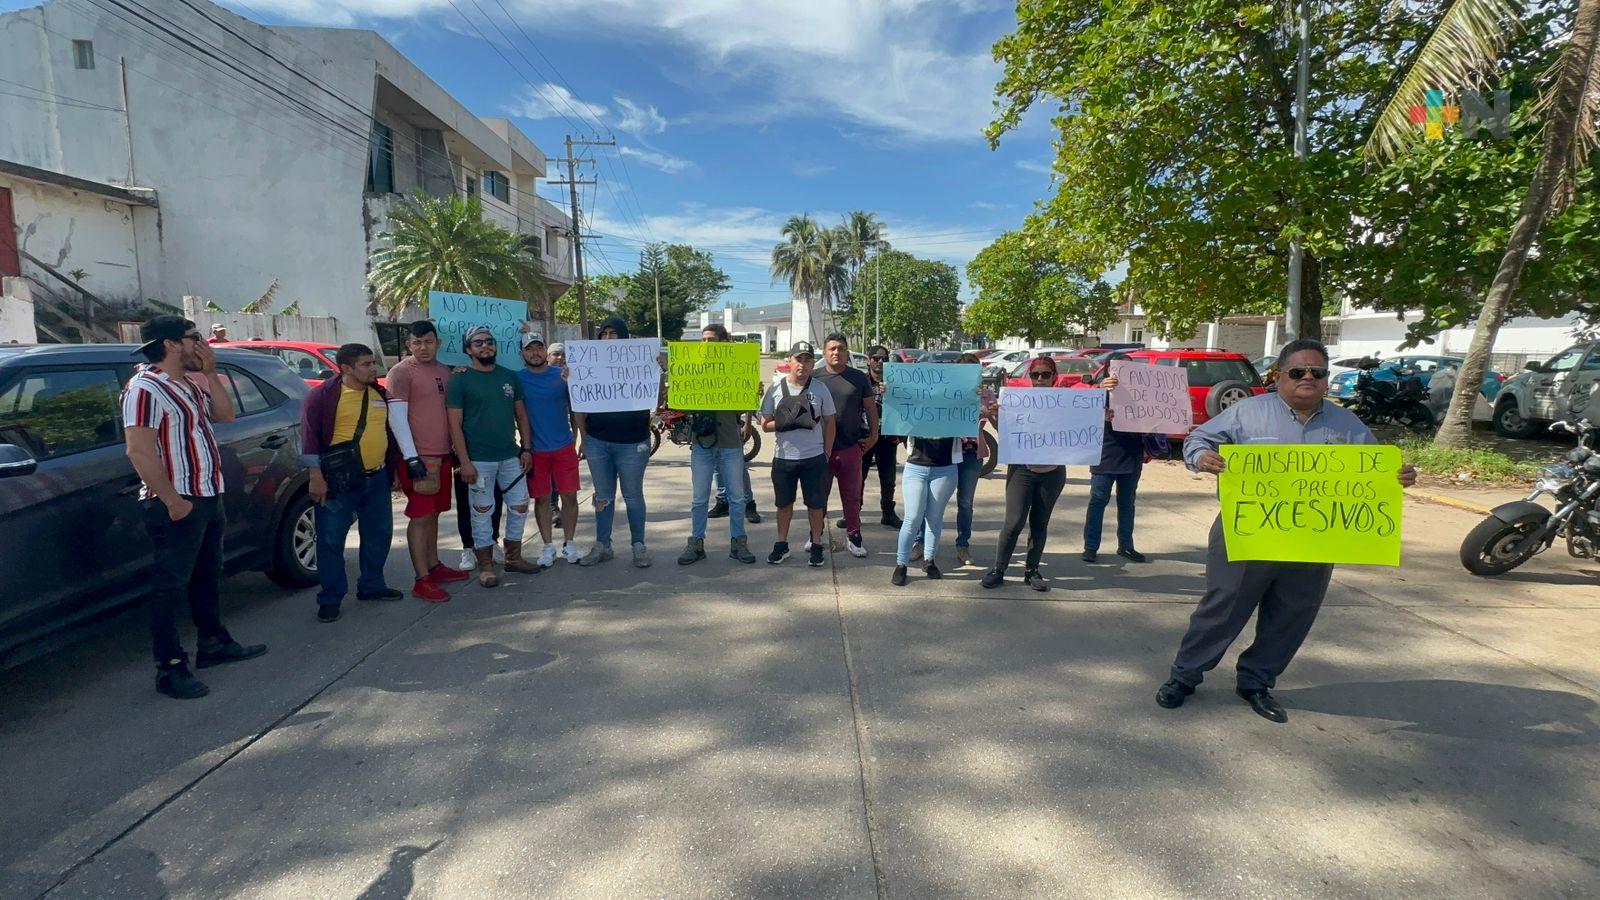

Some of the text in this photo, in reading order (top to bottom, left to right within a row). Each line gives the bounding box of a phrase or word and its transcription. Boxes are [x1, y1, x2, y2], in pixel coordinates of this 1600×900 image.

[442, 296, 467, 313] NO
[607, 345, 653, 363] BASTA
[698, 345, 737, 360] GENTE
[575, 365, 653, 382] DE TANTA
[670, 362, 726, 377] CORRUPTA
[672, 377, 756, 393] ACABANDO CON
[943, 388, 963, 400] LA
[1130, 389, 1177, 406] DE LOS
[899, 403, 978, 425] JUSTICIA?
[1016, 413, 1037, 426] EL
[1227, 450, 1389, 474] CANSADOS DE
[1241, 479, 1377, 500] LOS PRECIOS
[1233, 499, 1395, 537] EXCESIVOS
